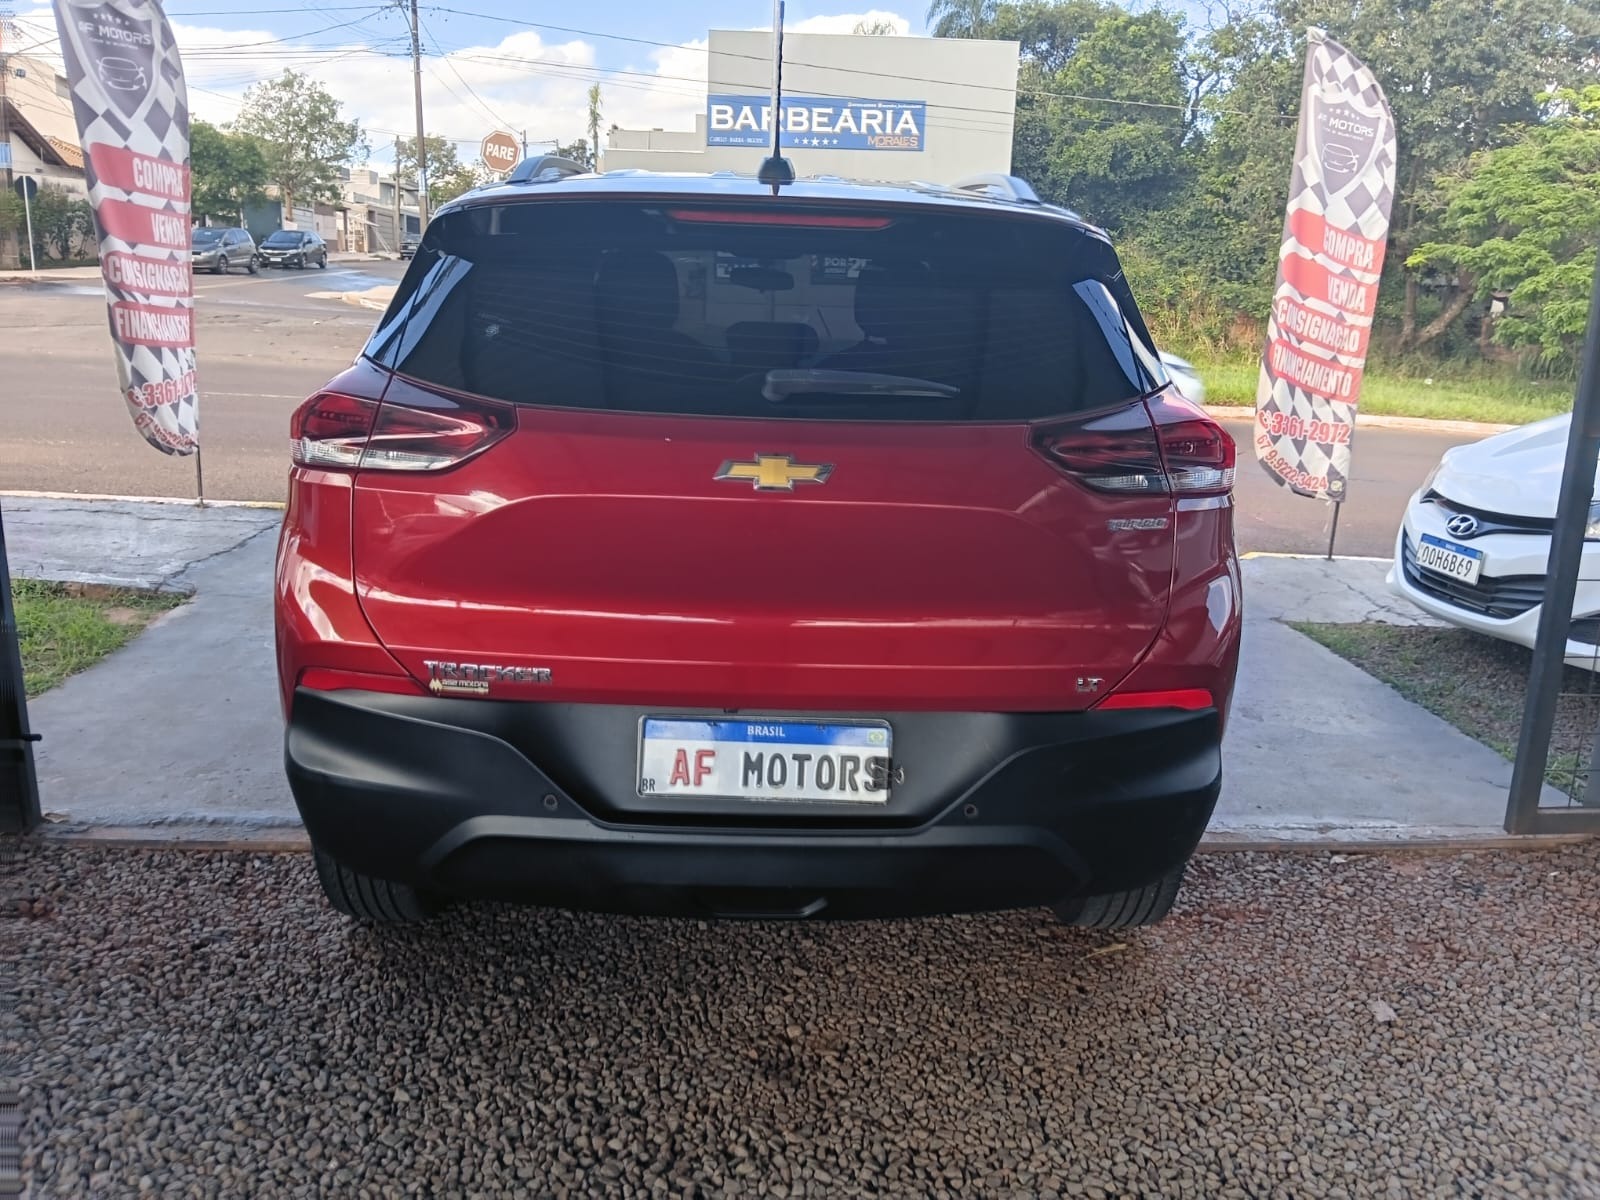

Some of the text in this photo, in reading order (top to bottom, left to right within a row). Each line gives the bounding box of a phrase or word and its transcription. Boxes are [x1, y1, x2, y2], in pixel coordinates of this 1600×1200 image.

[98, 25, 152, 45] MOTORS
[710, 104, 920, 136] BARBEARIA
[1328, 117, 1375, 137] MOTORS
[485, 143, 515, 161] PARE
[867, 135, 919, 147] MORALES
[132, 156, 184, 196] COMPRA
[151, 213, 187, 247] VENDA
[1323, 225, 1374, 269] COMPRA
[1271, 412, 1351, 444] 3361-2972
[423, 660, 552, 682] TRACKER
[747, 725, 786, 737] BRASIL
[669, 748, 885, 792] AF MOTORS
[641, 778, 656, 792] BR
